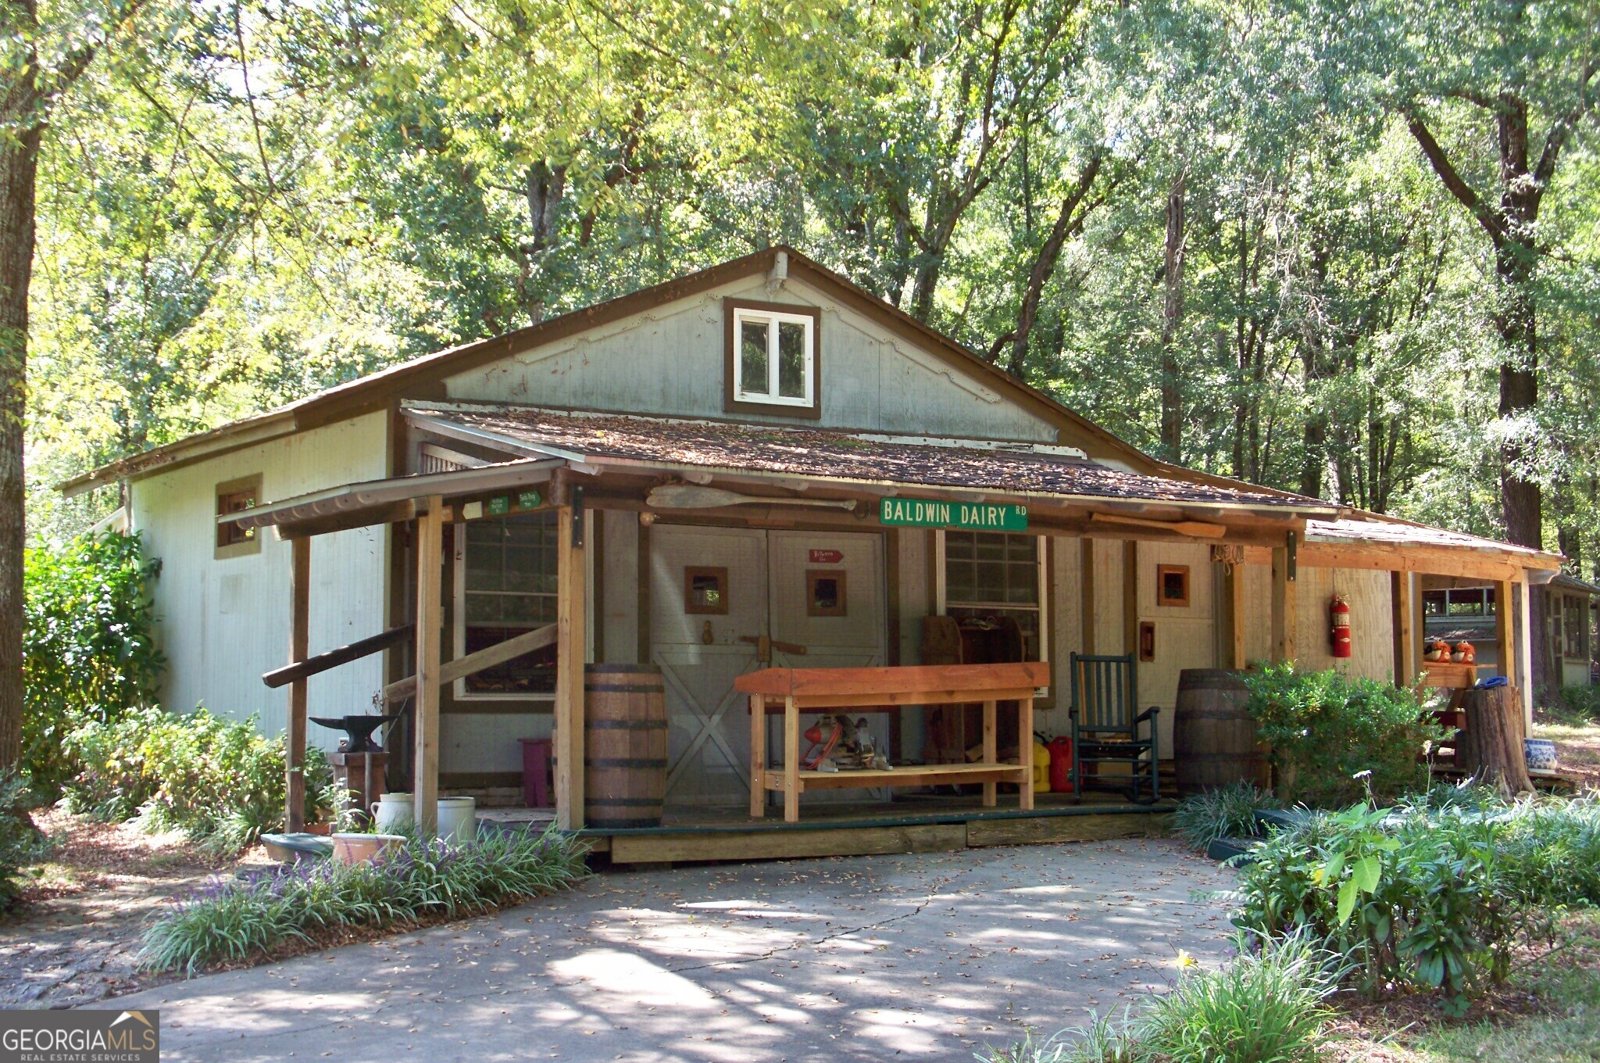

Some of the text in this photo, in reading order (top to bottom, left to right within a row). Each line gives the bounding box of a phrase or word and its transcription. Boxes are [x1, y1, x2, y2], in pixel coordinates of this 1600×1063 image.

[884, 500, 1027, 526] BALDWIN DAIRY RD
